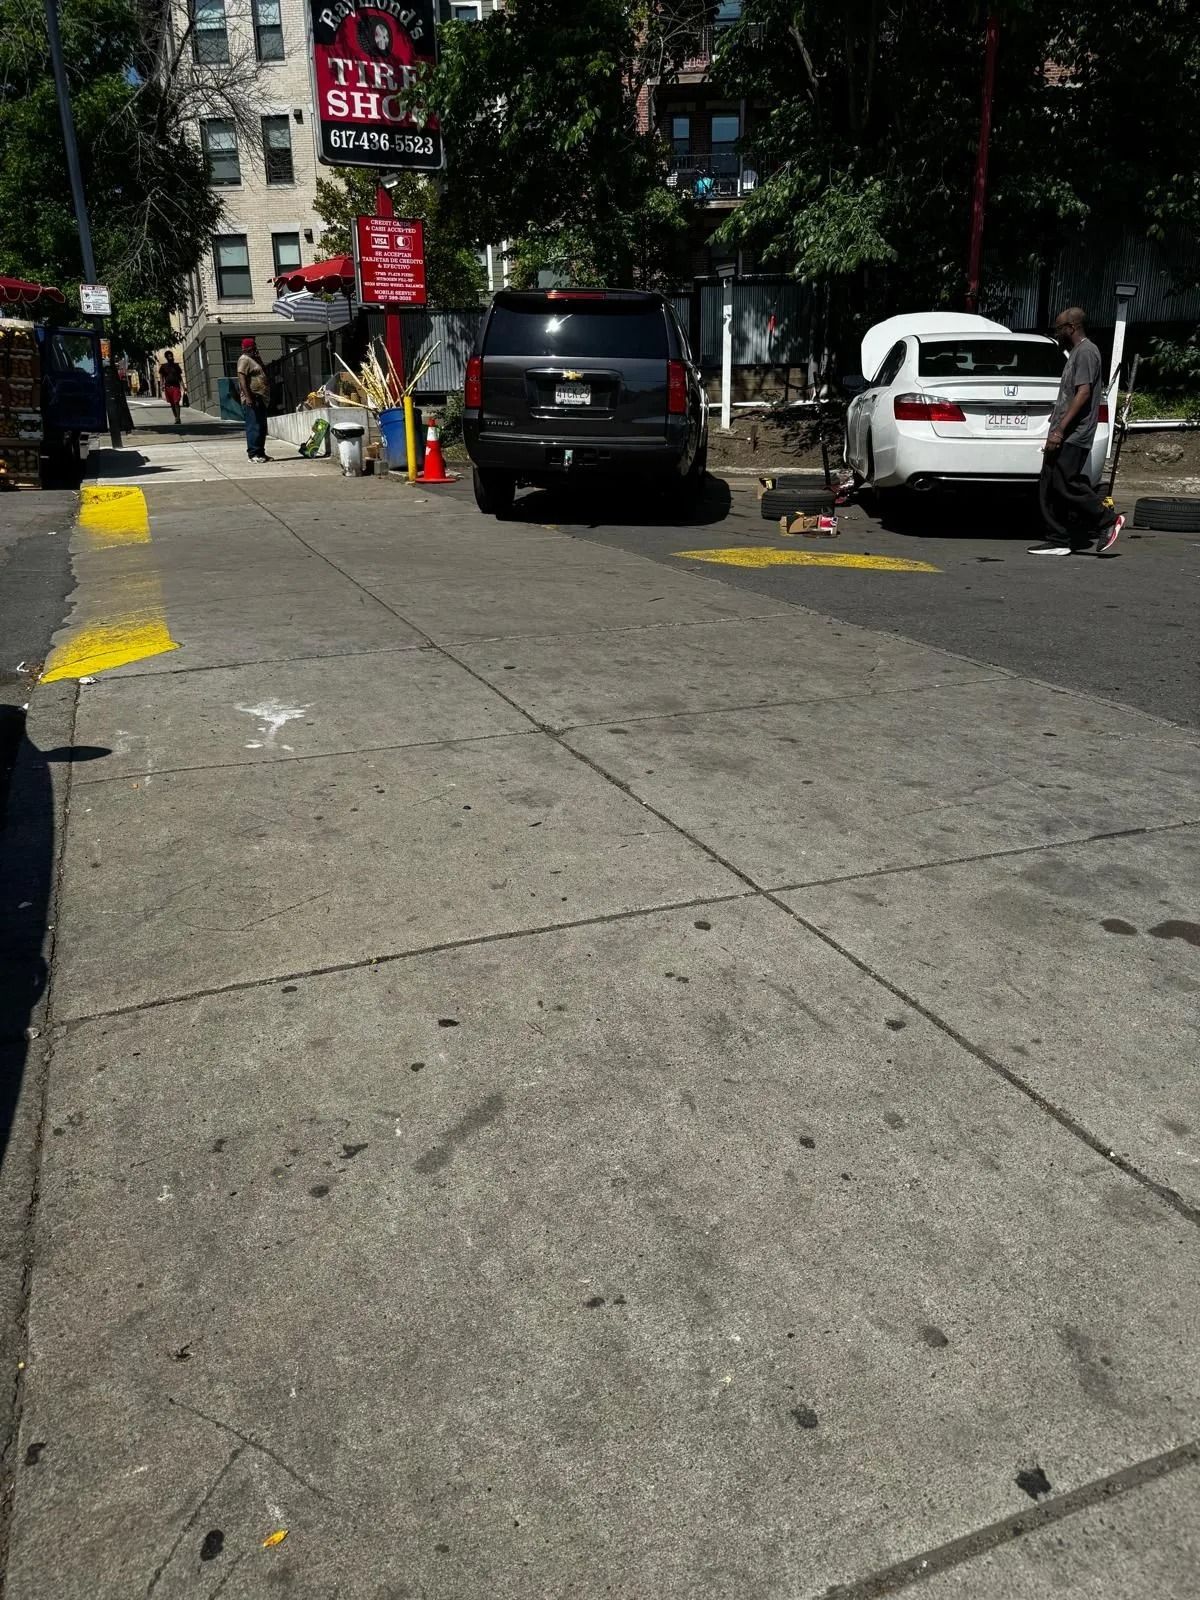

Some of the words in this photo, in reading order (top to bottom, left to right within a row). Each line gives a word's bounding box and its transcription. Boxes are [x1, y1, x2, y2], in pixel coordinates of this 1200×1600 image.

[327, 89, 424, 122] SHO
[330, 129, 434, 155] 617-436-5523
[988, 414, 1012, 425] 2LFE
[1014, 414, 1027, 425] 62
